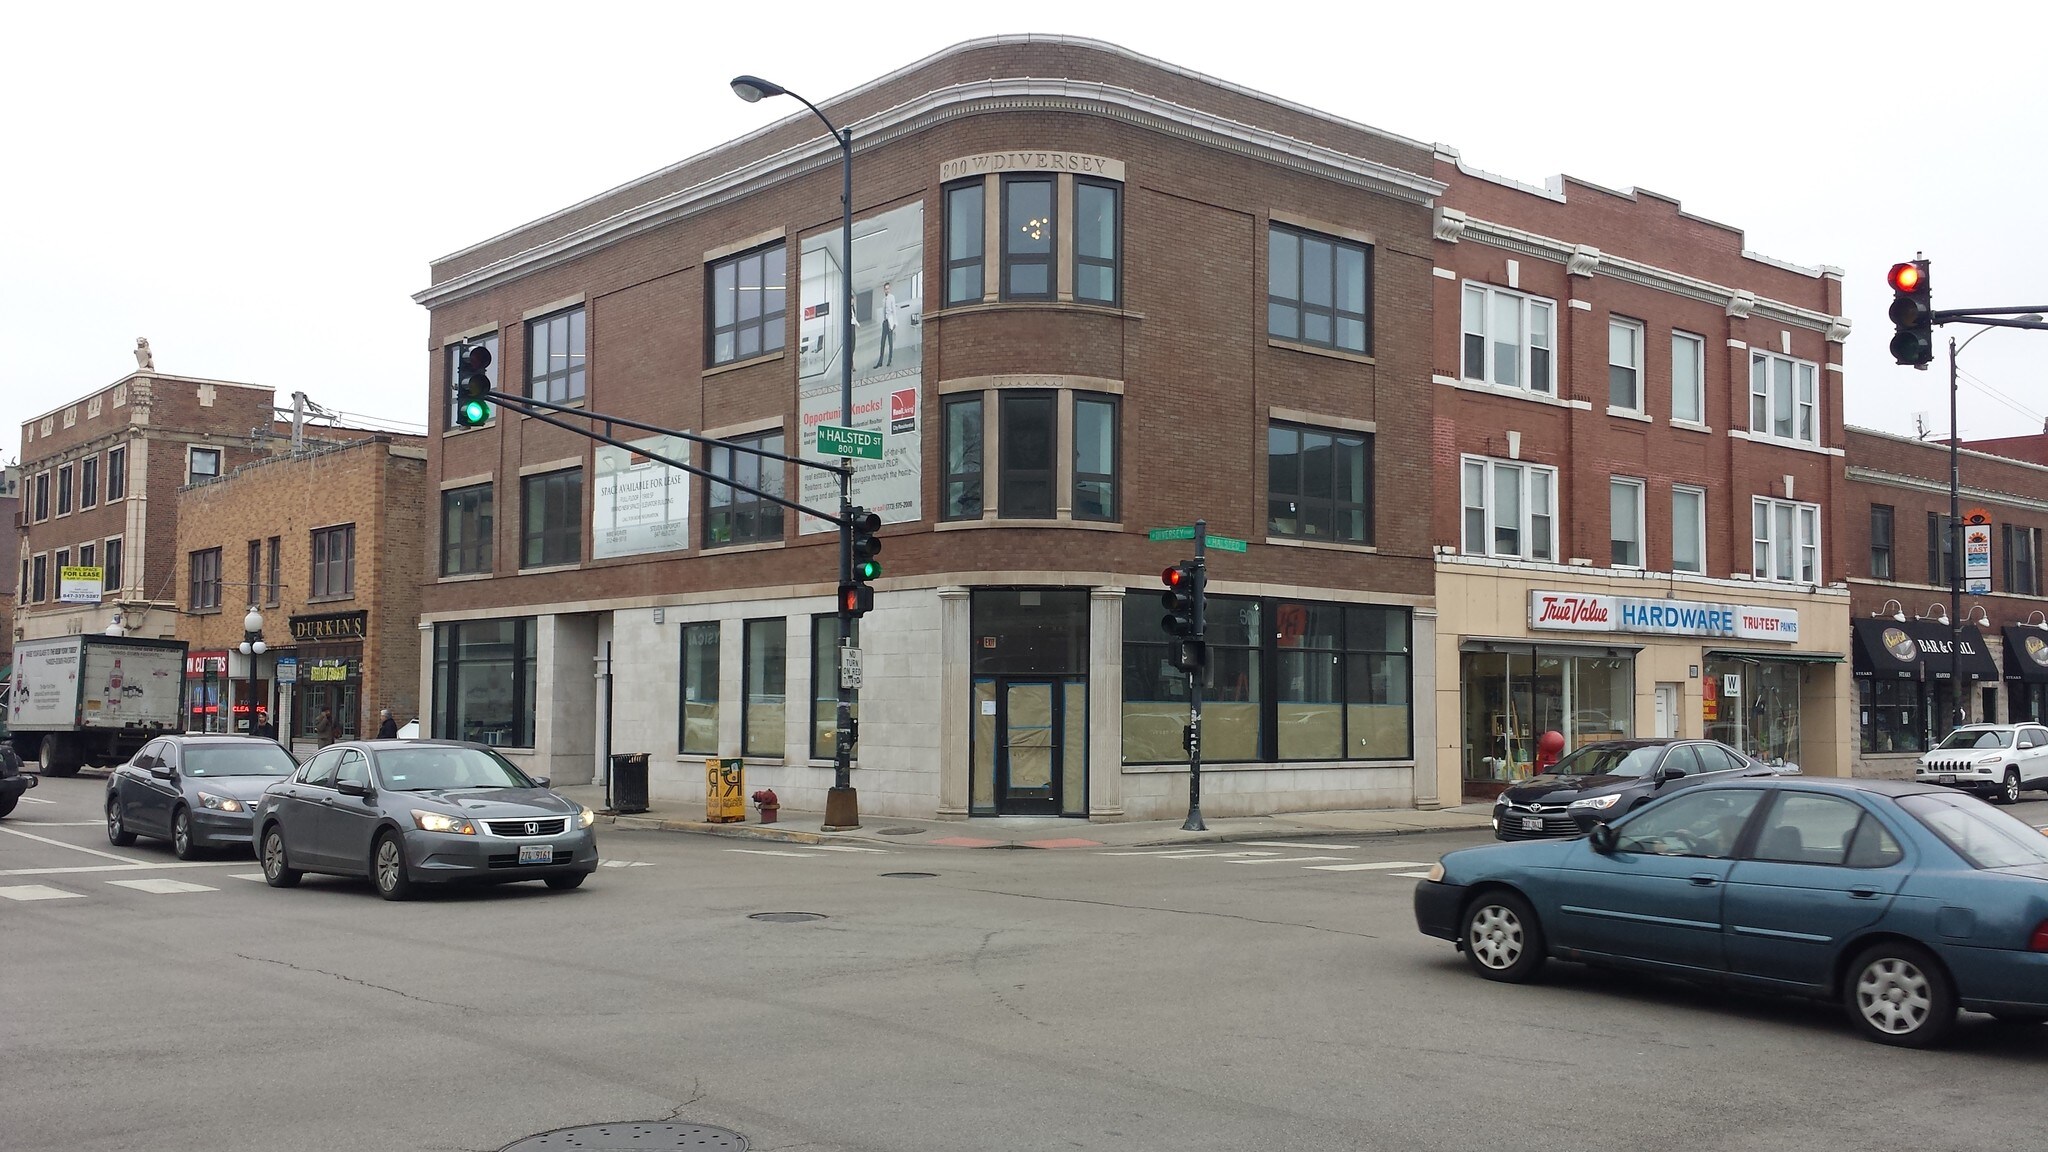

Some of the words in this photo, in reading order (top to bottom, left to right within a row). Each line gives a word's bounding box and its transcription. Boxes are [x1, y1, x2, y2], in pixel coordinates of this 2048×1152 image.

[943, 159, 967, 178] 800
[972, 157, 989, 170] W
[993, 153, 1106, 175] DIVERSEY
[803, 406, 842, 426] Opportuni
[819, 430, 825, 439] N
[827, 429, 871, 446] HALSTED
[873, 437, 881, 446] ST
[838, 445, 853, 454] 800
[857, 447, 863, 455] W
[618, 480, 649, 493] AVAILABLE
[650, 478, 663, 489] FOR
[664, 475, 681, 486] LEASE
[1540, 597, 1572, 622] True
[1563, 598, 1608, 624] Value
[1622, 604, 1733, 631] HARDWARE
[296, 617, 361, 637] DURKIN'S
[1743, 615, 1780, 631] TRU-TEST
[1780, 621, 1797, 633] PAINTS
[1917, 639, 1940, 653] BAR
[849, 650, 857, 658] NO
[846, 659, 859, 667] TURN
[843, 667, 851, 675] ON
[852, 668, 861, 676] RED
[1727, 676, 1737, 689] W
[232, 705, 267, 713] CLEARS
[536, 851, 550, 860] 9161
